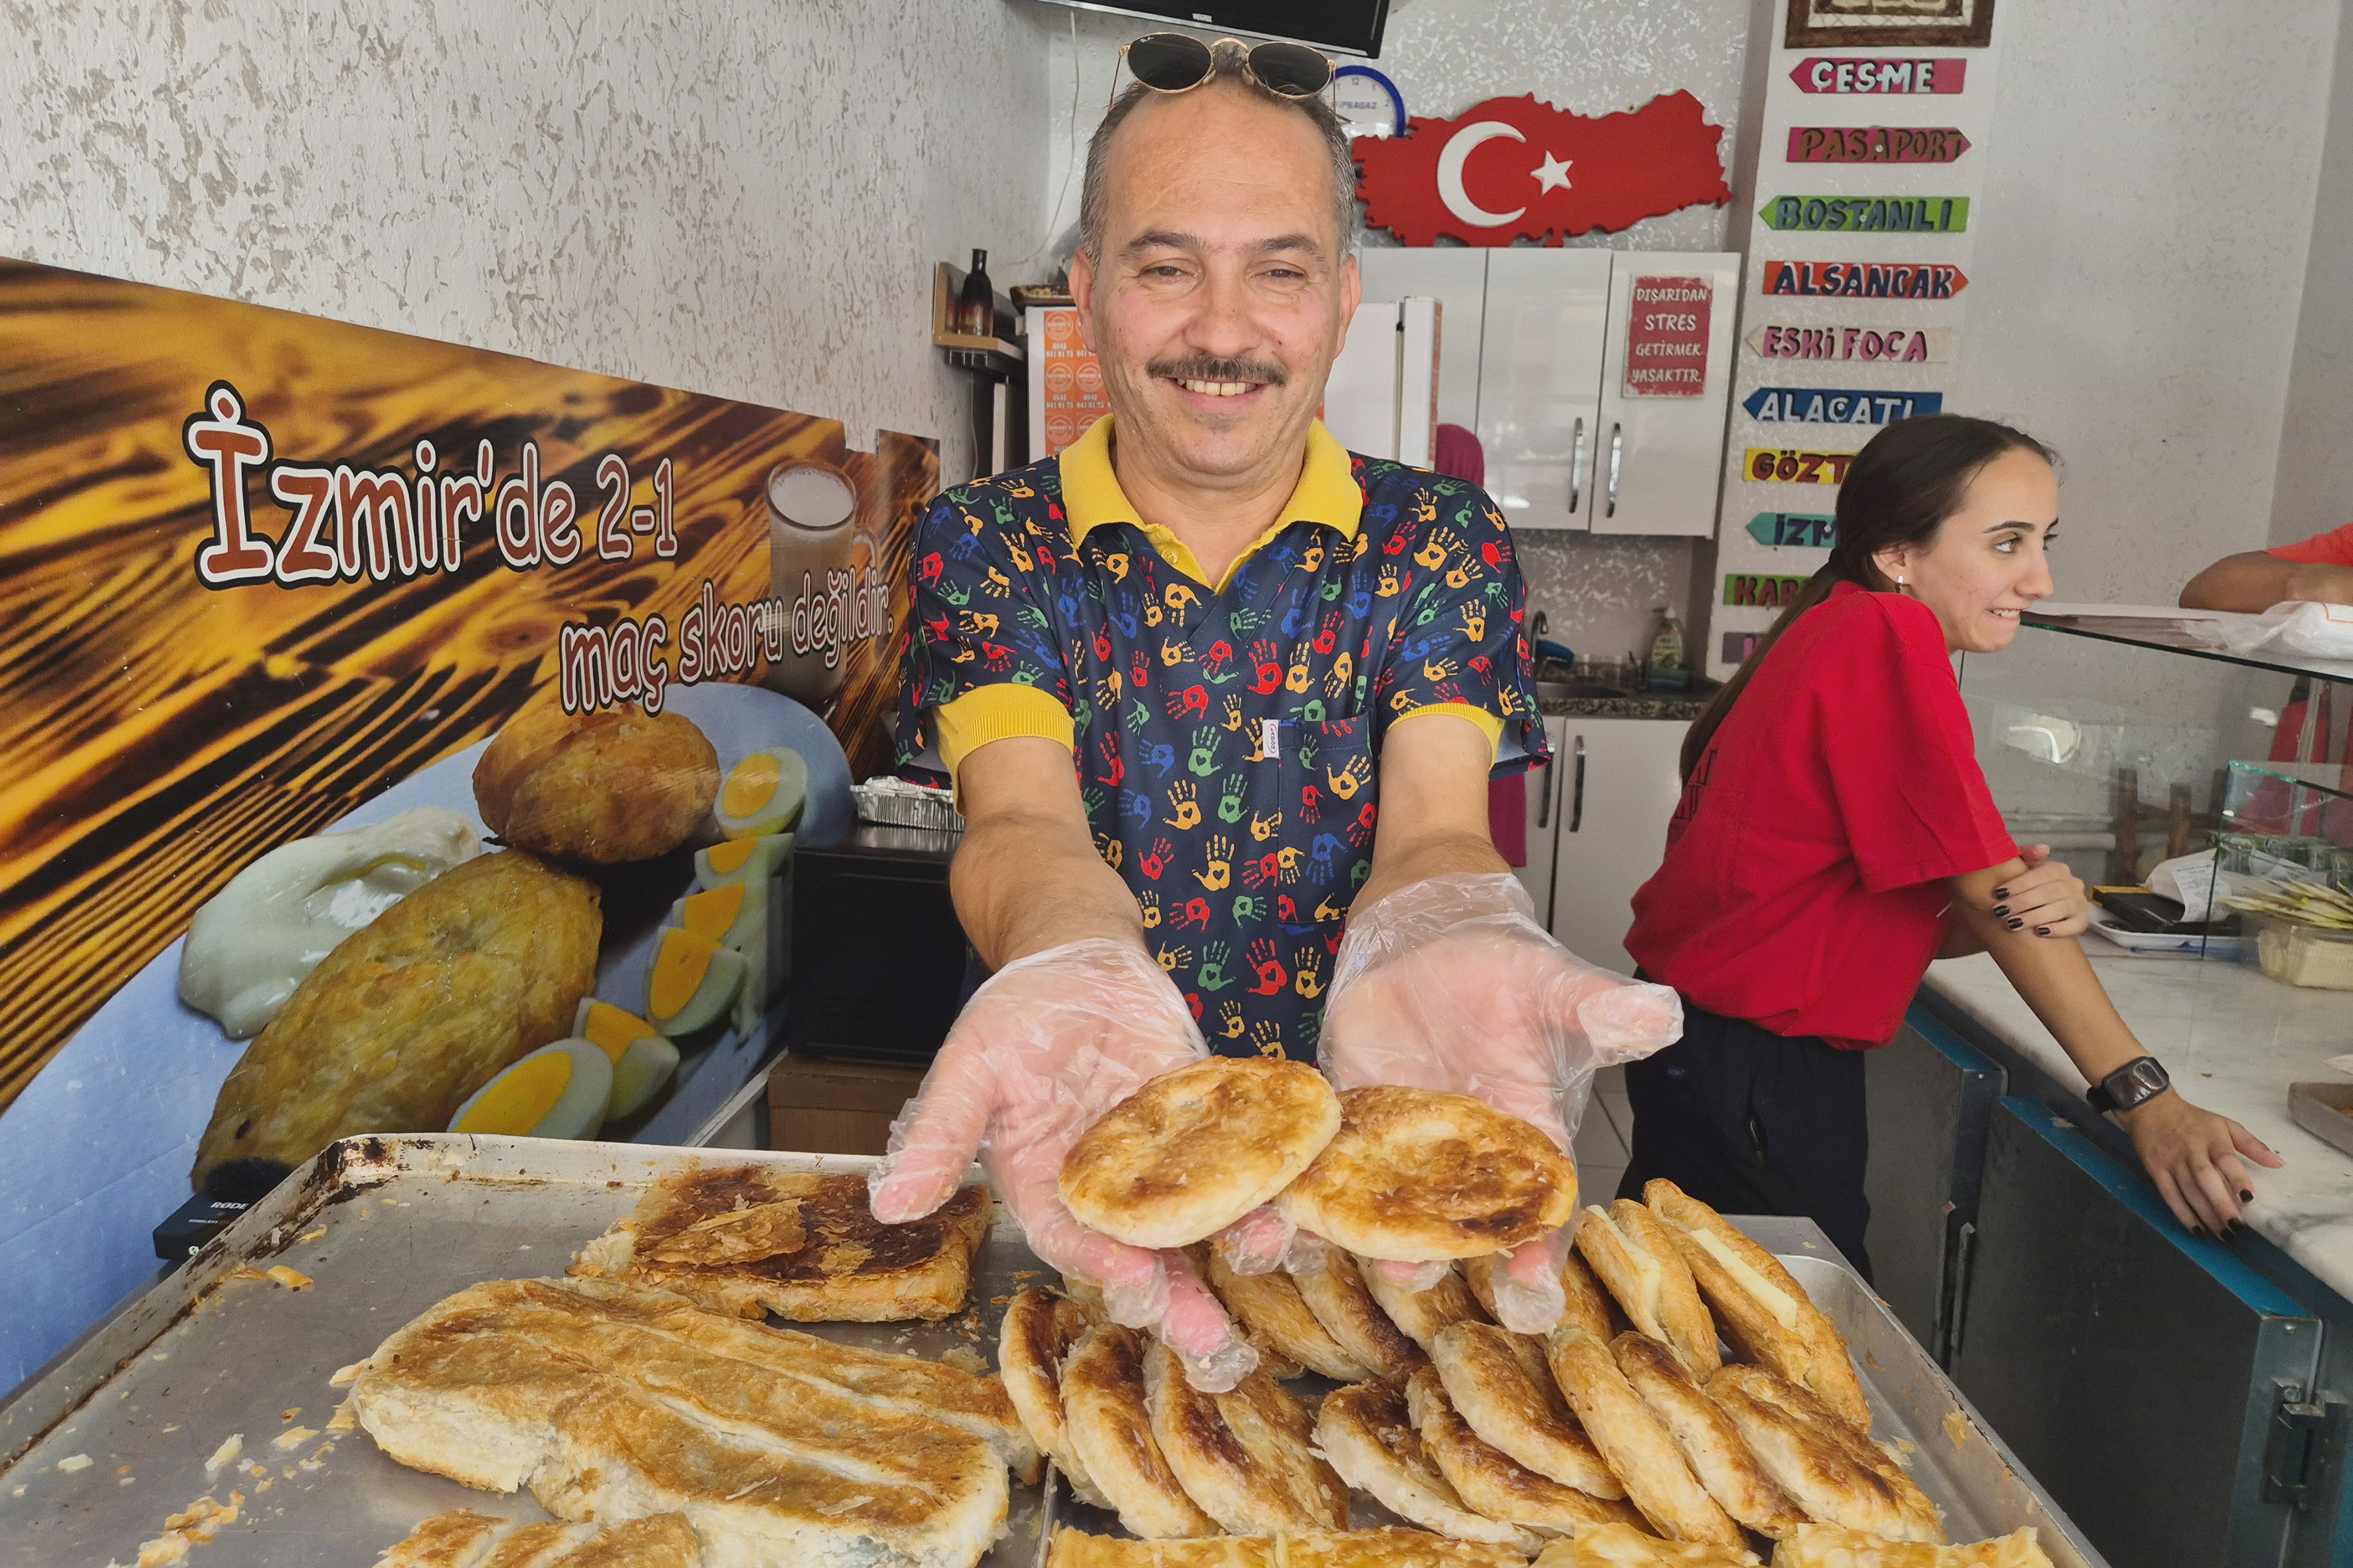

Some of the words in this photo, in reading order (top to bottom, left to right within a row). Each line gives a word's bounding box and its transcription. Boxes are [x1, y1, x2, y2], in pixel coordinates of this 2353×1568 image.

[1798, 128, 1963, 161] PASAPORT
[1776, 197, 1953, 230] BOSTANLI
[1636, 288, 1709, 304] DIŞARIDAN
[1773, 262, 1956, 298] ALSANCAK
[1644, 313, 1698, 331] STRES
[1636, 339, 1703, 357] GETİRMEK
[1632, 368, 1703, 383] YASAKTIR.
[187, 385, 582, 584] İzmir'de
[596, 453, 679, 561] 2-1
[561, 616, 668, 713] maç
[680, 581, 784, 683] skoru
[792, 566, 895, 669] değildir.
